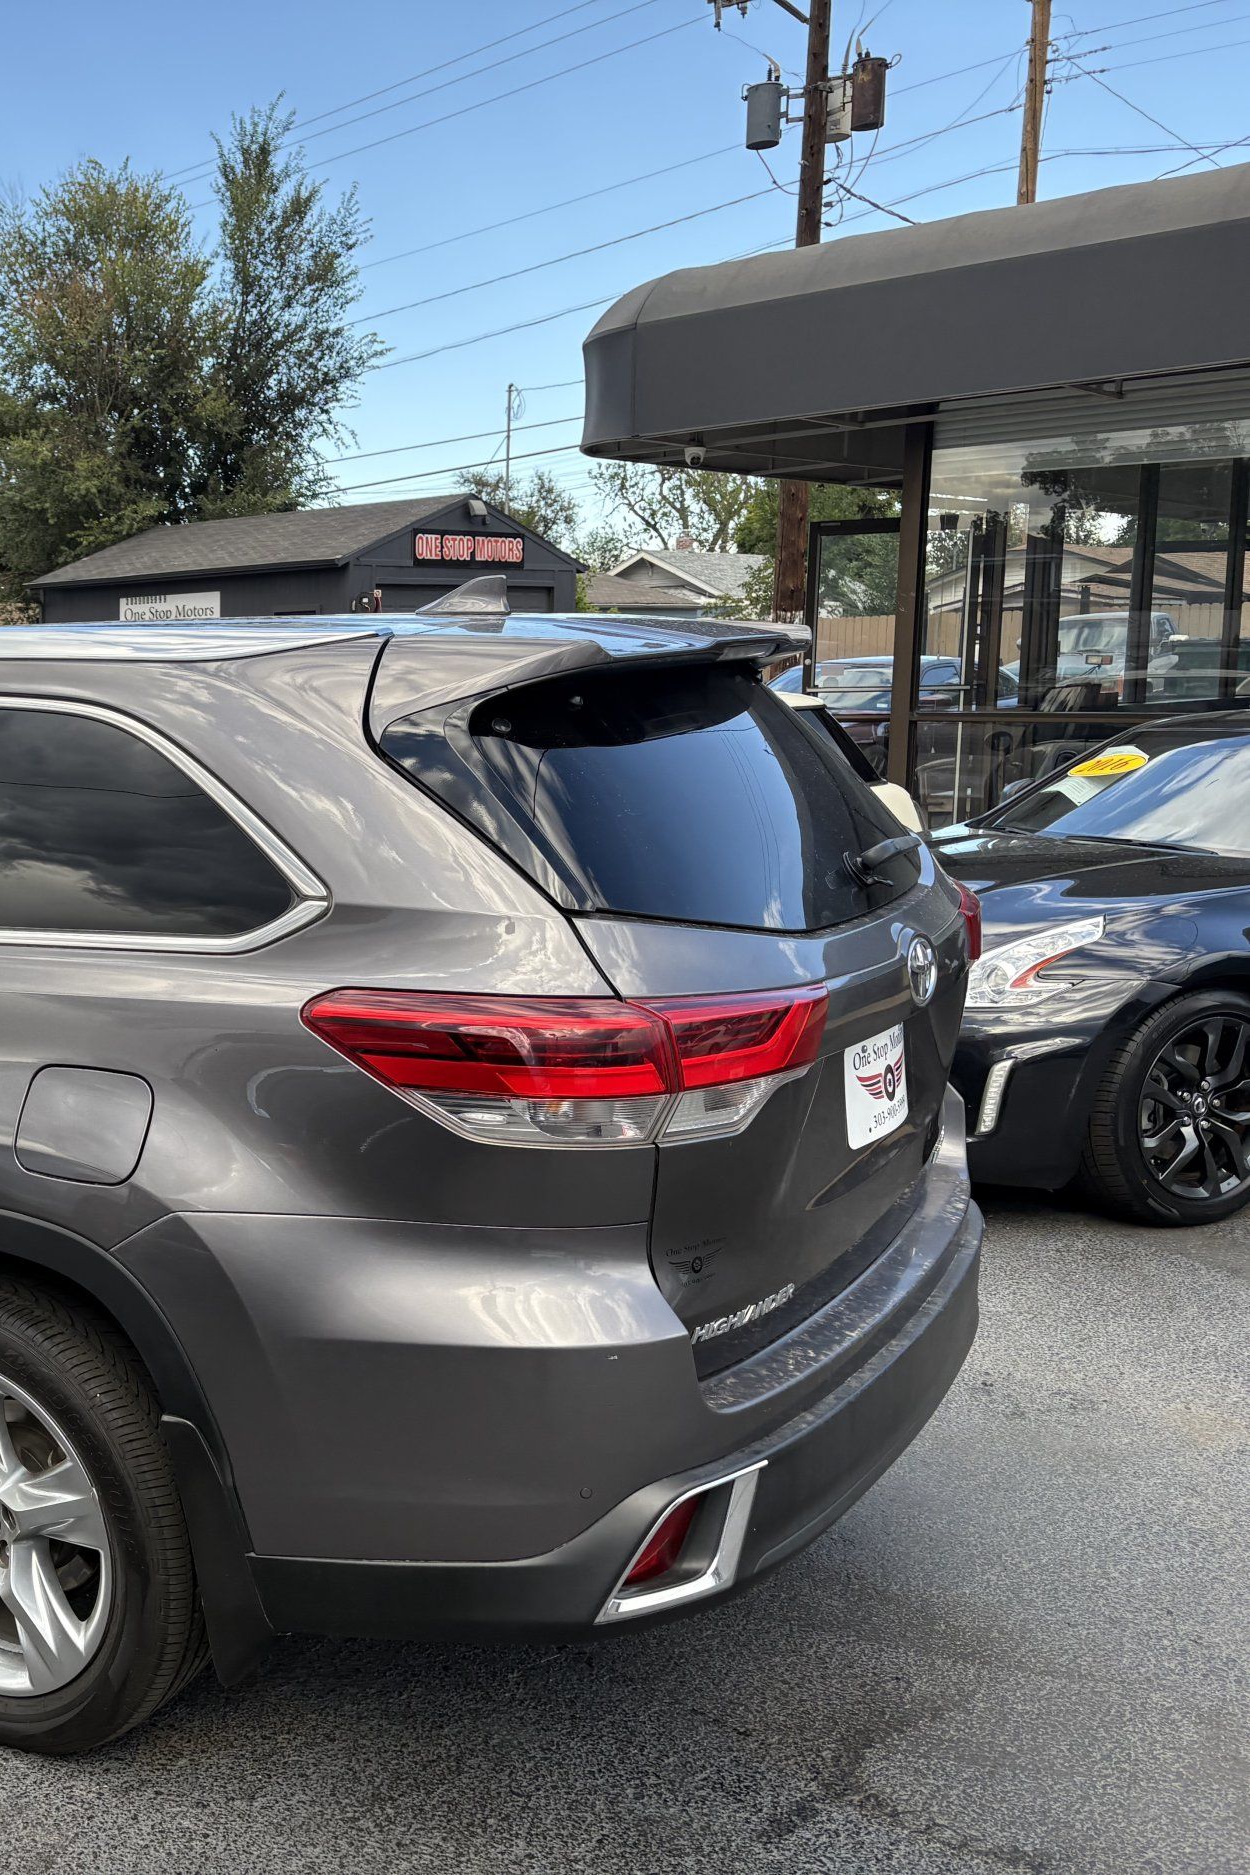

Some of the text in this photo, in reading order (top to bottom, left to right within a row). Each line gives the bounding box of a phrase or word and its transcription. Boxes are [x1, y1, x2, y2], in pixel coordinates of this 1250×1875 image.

[415, 533, 523, 562] ONE STOP MOTORS
[124, 604, 214, 620] One Stop Motors
[853, 1052, 870, 1070] One
[872, 1041, 889, 1062] Stop
[691, 1283, 795, 1345] HIGHLANDER
